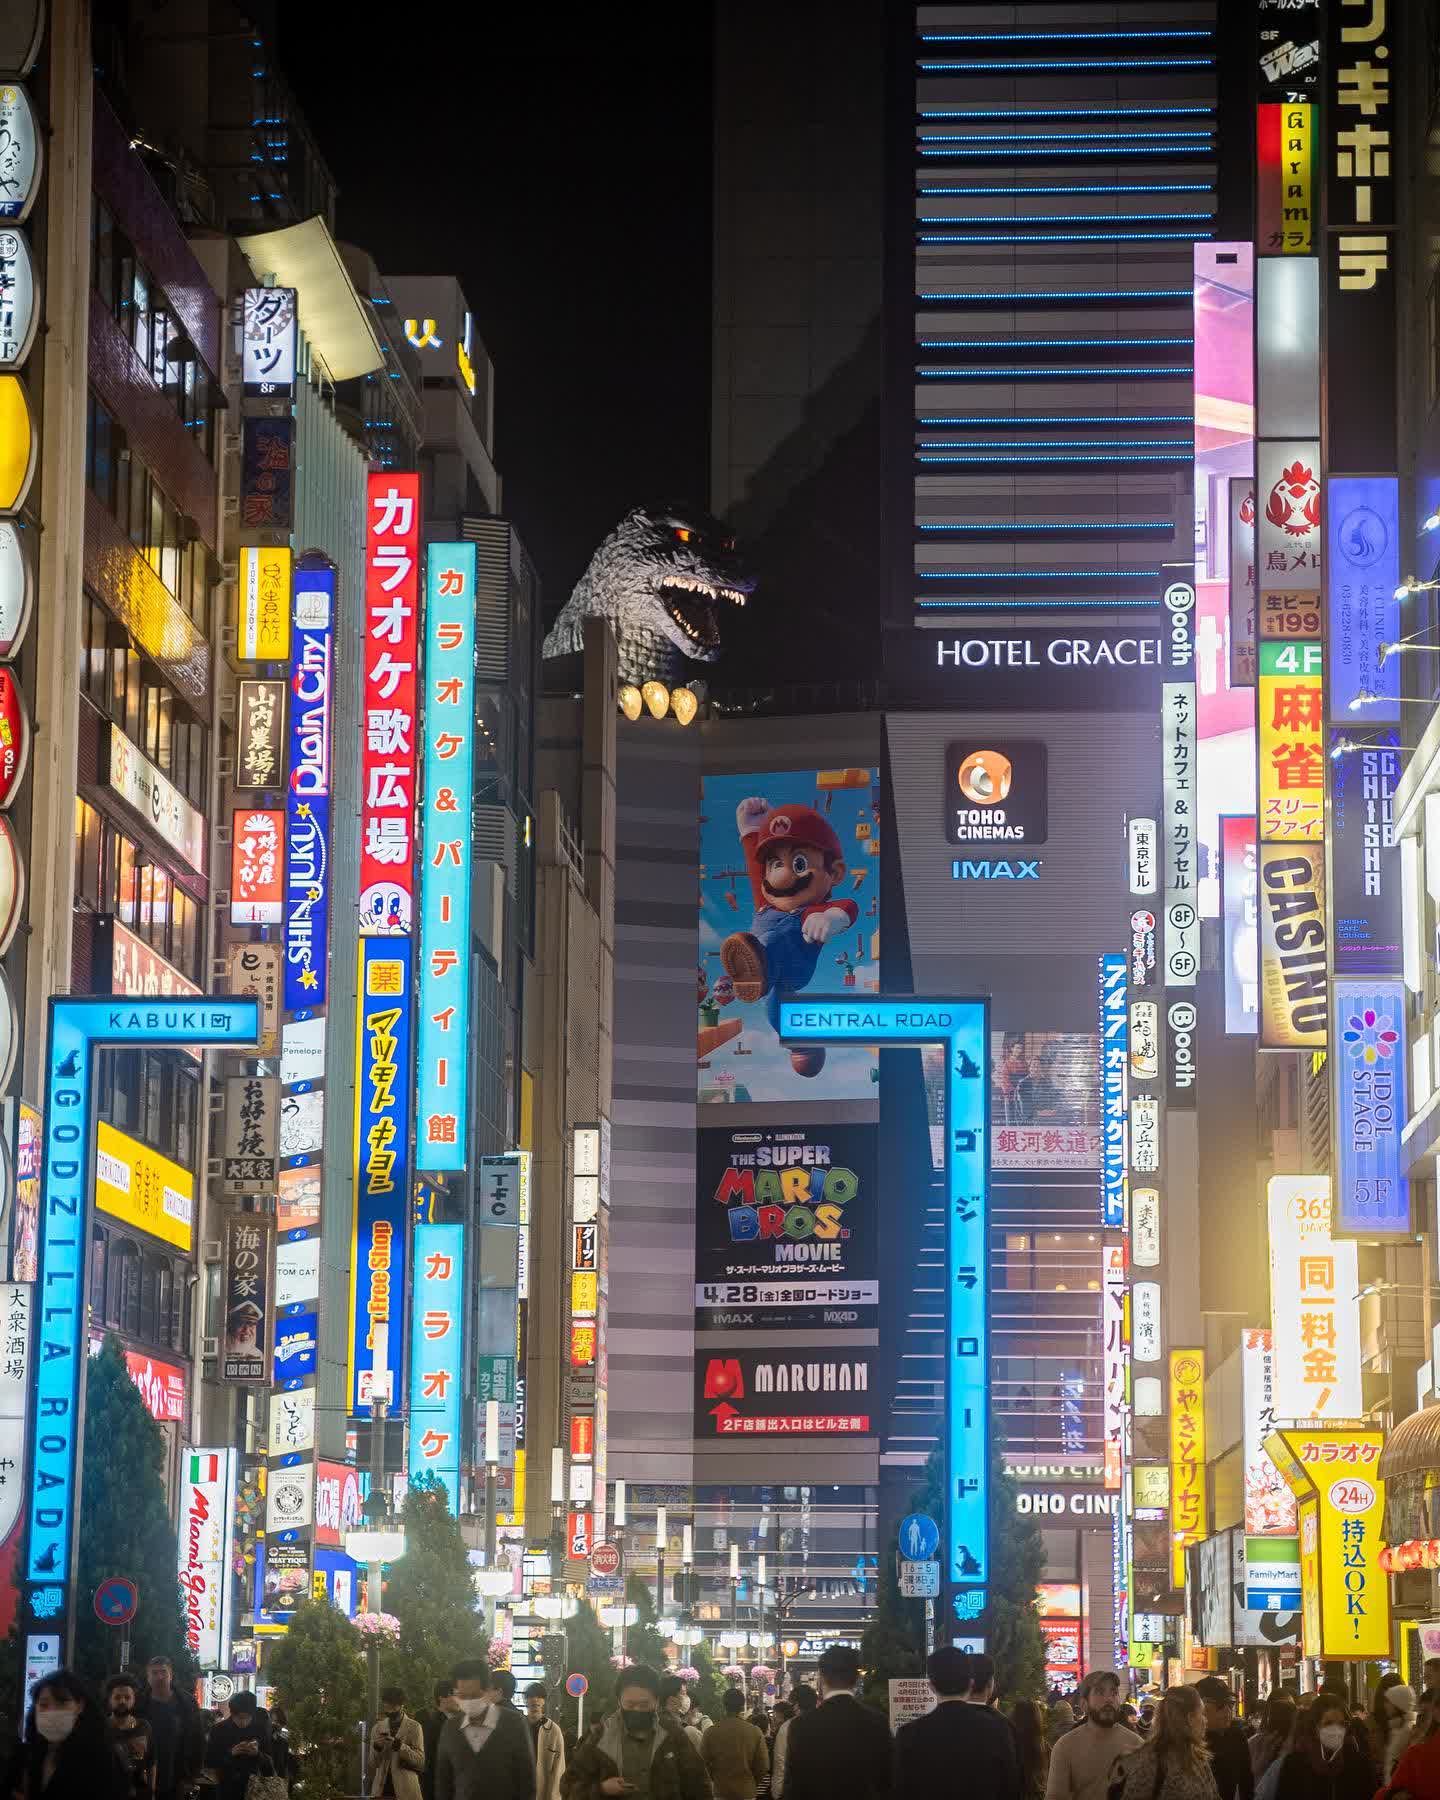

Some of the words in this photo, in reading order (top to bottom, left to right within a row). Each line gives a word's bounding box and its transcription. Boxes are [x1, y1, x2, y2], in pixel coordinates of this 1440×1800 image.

[1260, 31, 1279, 40] 8F
[1287, 92, 1306, 103] 7F
[1284, 111, 1309, 221] Garam
[253, 295, 287, 376] ダーツ
[261, 382, 275, 393] 8F
[1163, 582, 1196, 666] Booth
[937, 640, 1041, 666] HOTEL
[1047, 639, 1162, 665] GRACE
[1274, 645, 1322, 674] 4F
[365, 488, 413, 866] カラオケ歌広場
[244, 684, 276, 772] 山内農場
[1172, 693, 1190, 792] ネットカフェ
[1270, 685, 1323, 790] 麻雀
[957, 809, 1006, 825] TOHO
[1174, 800, 1188, 815] &
[1265, 798, 1319, 815] スリー
[1381, 752, 1395, 847] CLUB
[957, 825, 1025, 840] CINEMAS
[1363, 752, 1381, 896] SHISHA
[237, 836, 259, 898] さかい
[426, 569, 466, 1144] カラオケ&パーティー館
[952, 861, 1041, 880] IMAX
[1136, 832, 1150, 888] 東京ビル
[1172, 823, 1190, 890] カプセル
[245, 905, 267, 921] 4F
[288, 822, 324, 965] SHINJUKU
[1174, 911, 1191, 922] 8F
[370, 962, 400, 993] 薬
[1174, 959, 1191, 971] 5F
[790, 1013, 888, 1027] CENTRAL
[895, 1013, 952, 1027] ROAD
[1104, 965, 1127, 1039] 747
[283, 1047, 323, 1055] Penelope
[1167, 1001, 1197, 1088] Booth
[237, 1080, 266, 1158] お好み焼
[366, 1007, 402, 1195] マツモトキヨシ
[1353, 1071, 1373, 1152] STAGE
[1373, 1071, 1393, 1138] IDOL
[227, 1160, 271, 1179] 大阪家
[731, 1153, 757, 1166] THE
[756, 1145, 831, 1166] SUPER
[713, 1166, 860, 1206] MARIO
[1354, 1178, 1392, 1204] 5F
[42, 1089, 83, 1363] GODZILLA
[369, 1220, 393, 1270] Shop
[582, 1227, 595, 1260] ダーツ
[234, 1225, 261, 1298] 海の家
[277, 1267, 296, 1277] TOM
[299, 1267, 316, 1276] CAT
[775, 1243, 842, 1262] MOVIE
[368, 1270, 390, 1314] Free
[712, 1312, 755, 1325] IMAX
[953, 1127, 983, 1499] ゴジラロード
[4, 1288, 27, 1381] 大衆酒場
[573, 1328, 594, 1362] 麻雀
[420, 1252, 452, 1459] カラオケ
[754, 1362, 868, 1392] MARUHAN
[35, 1396, 69, 1529] ROAD
[1301, 1442, 1381, 1463] カラオケ
[1337, 1486, 1369, 1506] 24H
[593, 1553, 619, 1567] 消火栓
[1249, 1569, 1299, 1581] FamilyMart
[1341, 1518, 1369, 1641] 持込OK!
